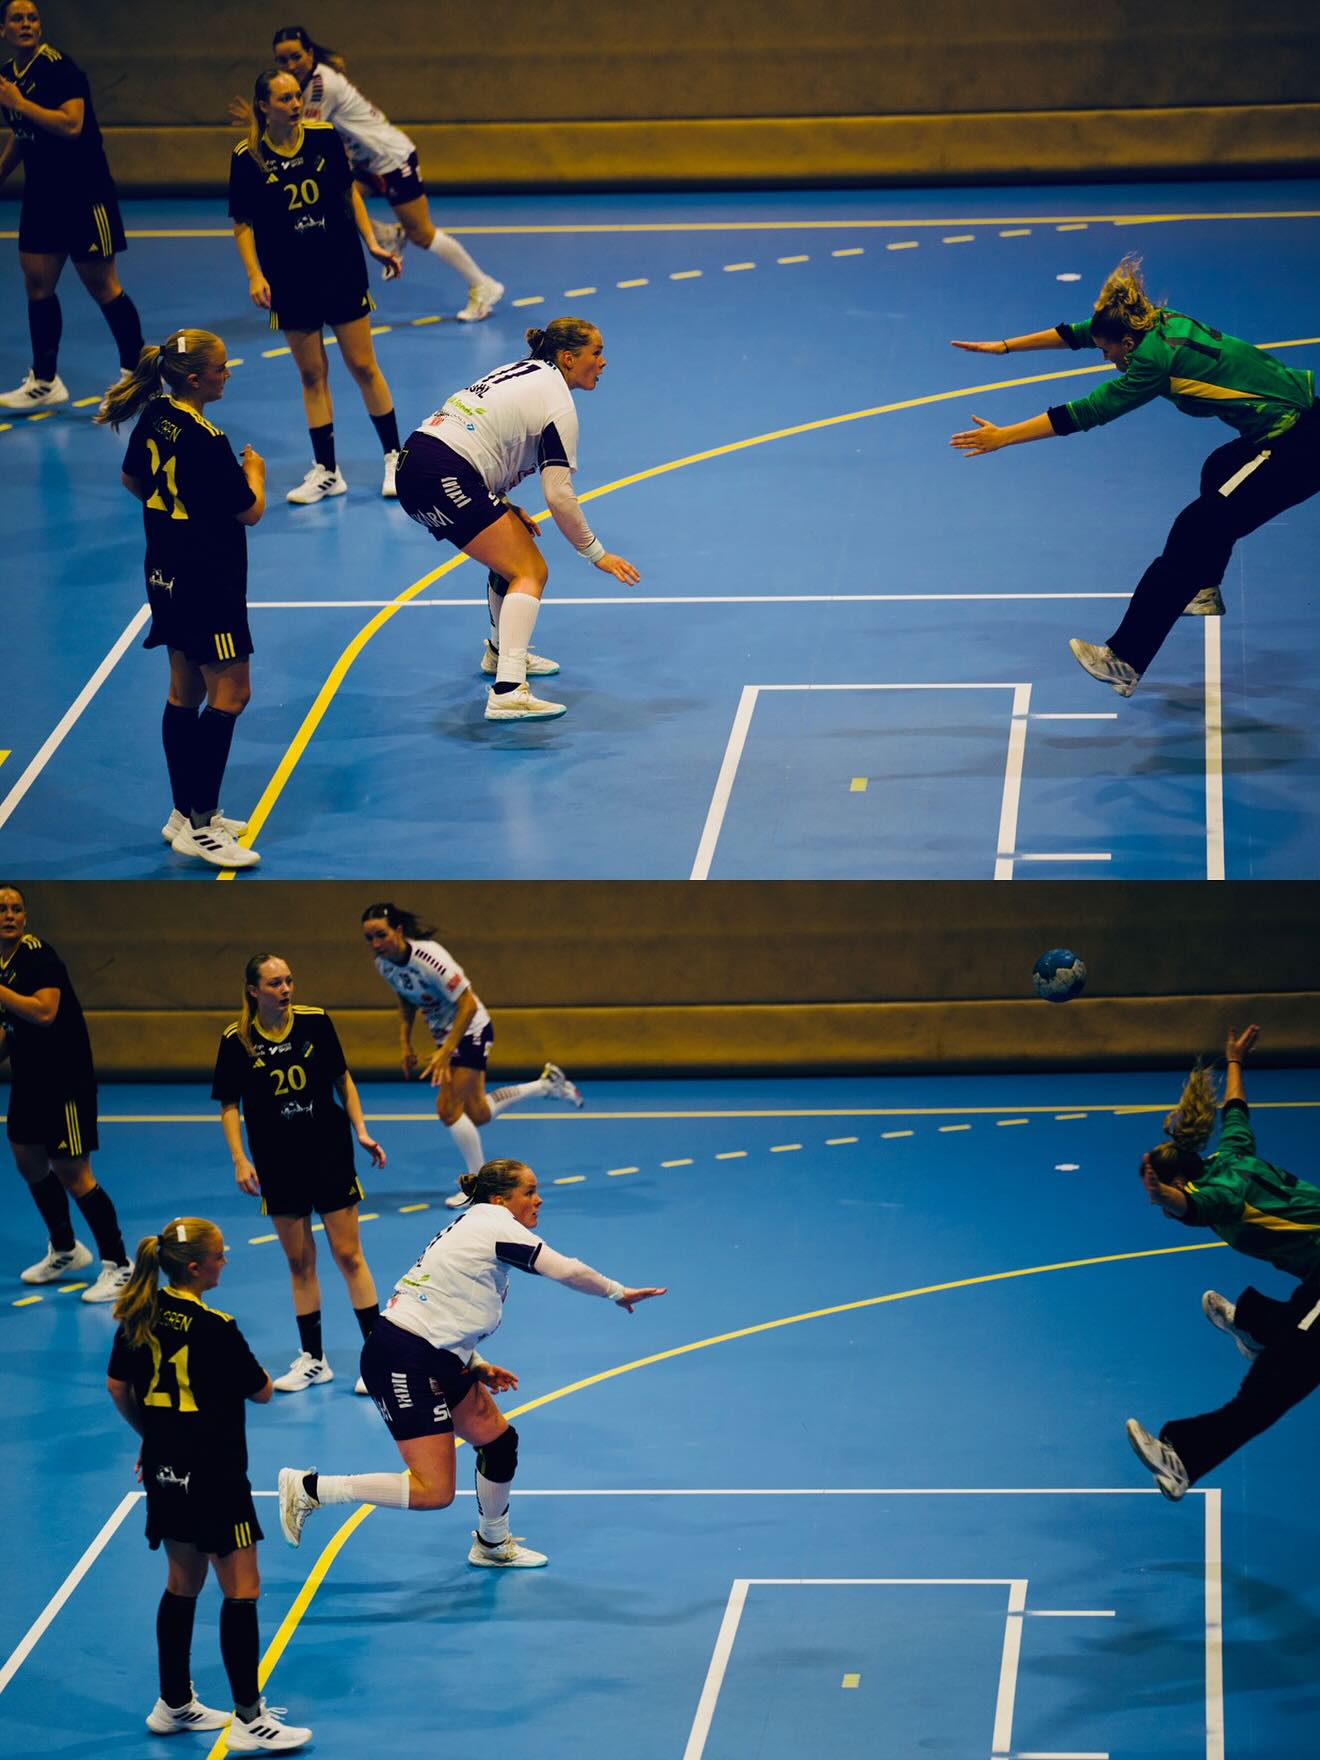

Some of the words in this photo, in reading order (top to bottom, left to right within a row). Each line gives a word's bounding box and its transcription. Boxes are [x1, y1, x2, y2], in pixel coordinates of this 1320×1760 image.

[283, 178, 320, 211] 20
[146, 438, 189, 519] 21
[270, 1065, 307, 1096] 20
[143, 1330, 199, 1412] 21
